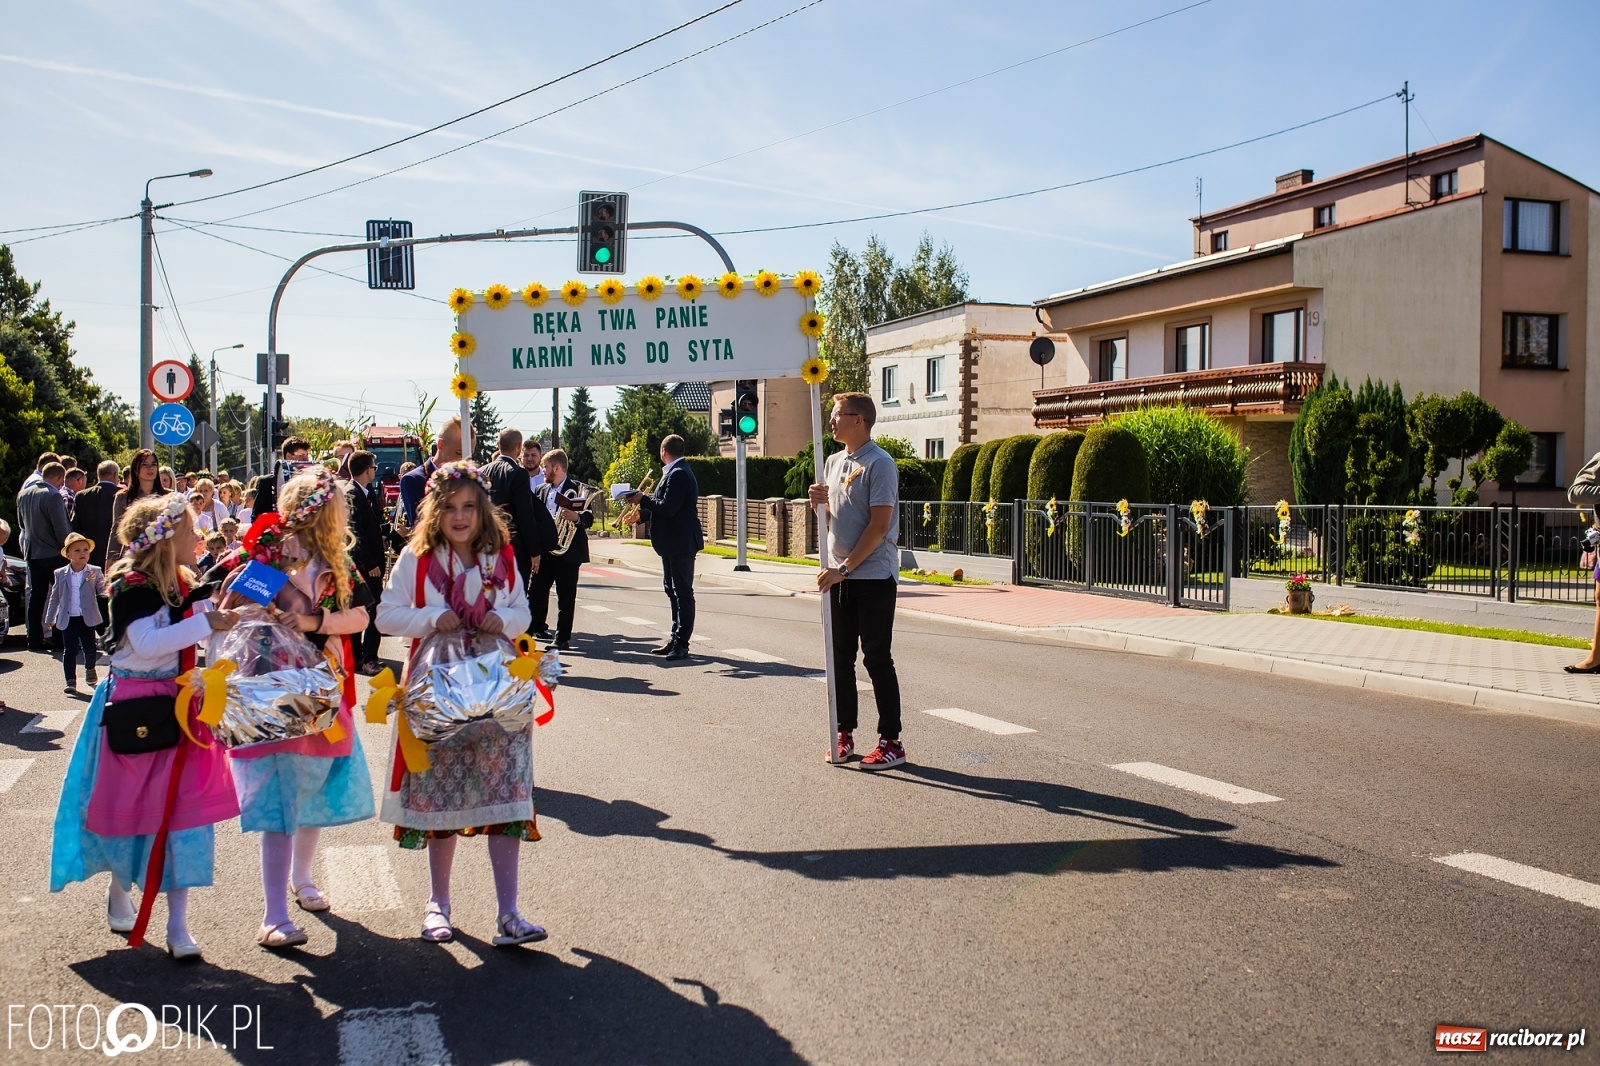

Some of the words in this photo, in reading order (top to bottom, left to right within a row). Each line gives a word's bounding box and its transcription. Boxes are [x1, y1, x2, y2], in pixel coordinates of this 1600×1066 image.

[533, 311, 582, 342] RĘKA
[598, 308, 637, 331] TWA
[1307, 311, 1320, 327] 19
[591, 342, 627, 366] NAS
[645, 341, 669, 364] DO
[687, 338, 734, 363] SYTA
[243, 581, 272, 598] RUDNIK
